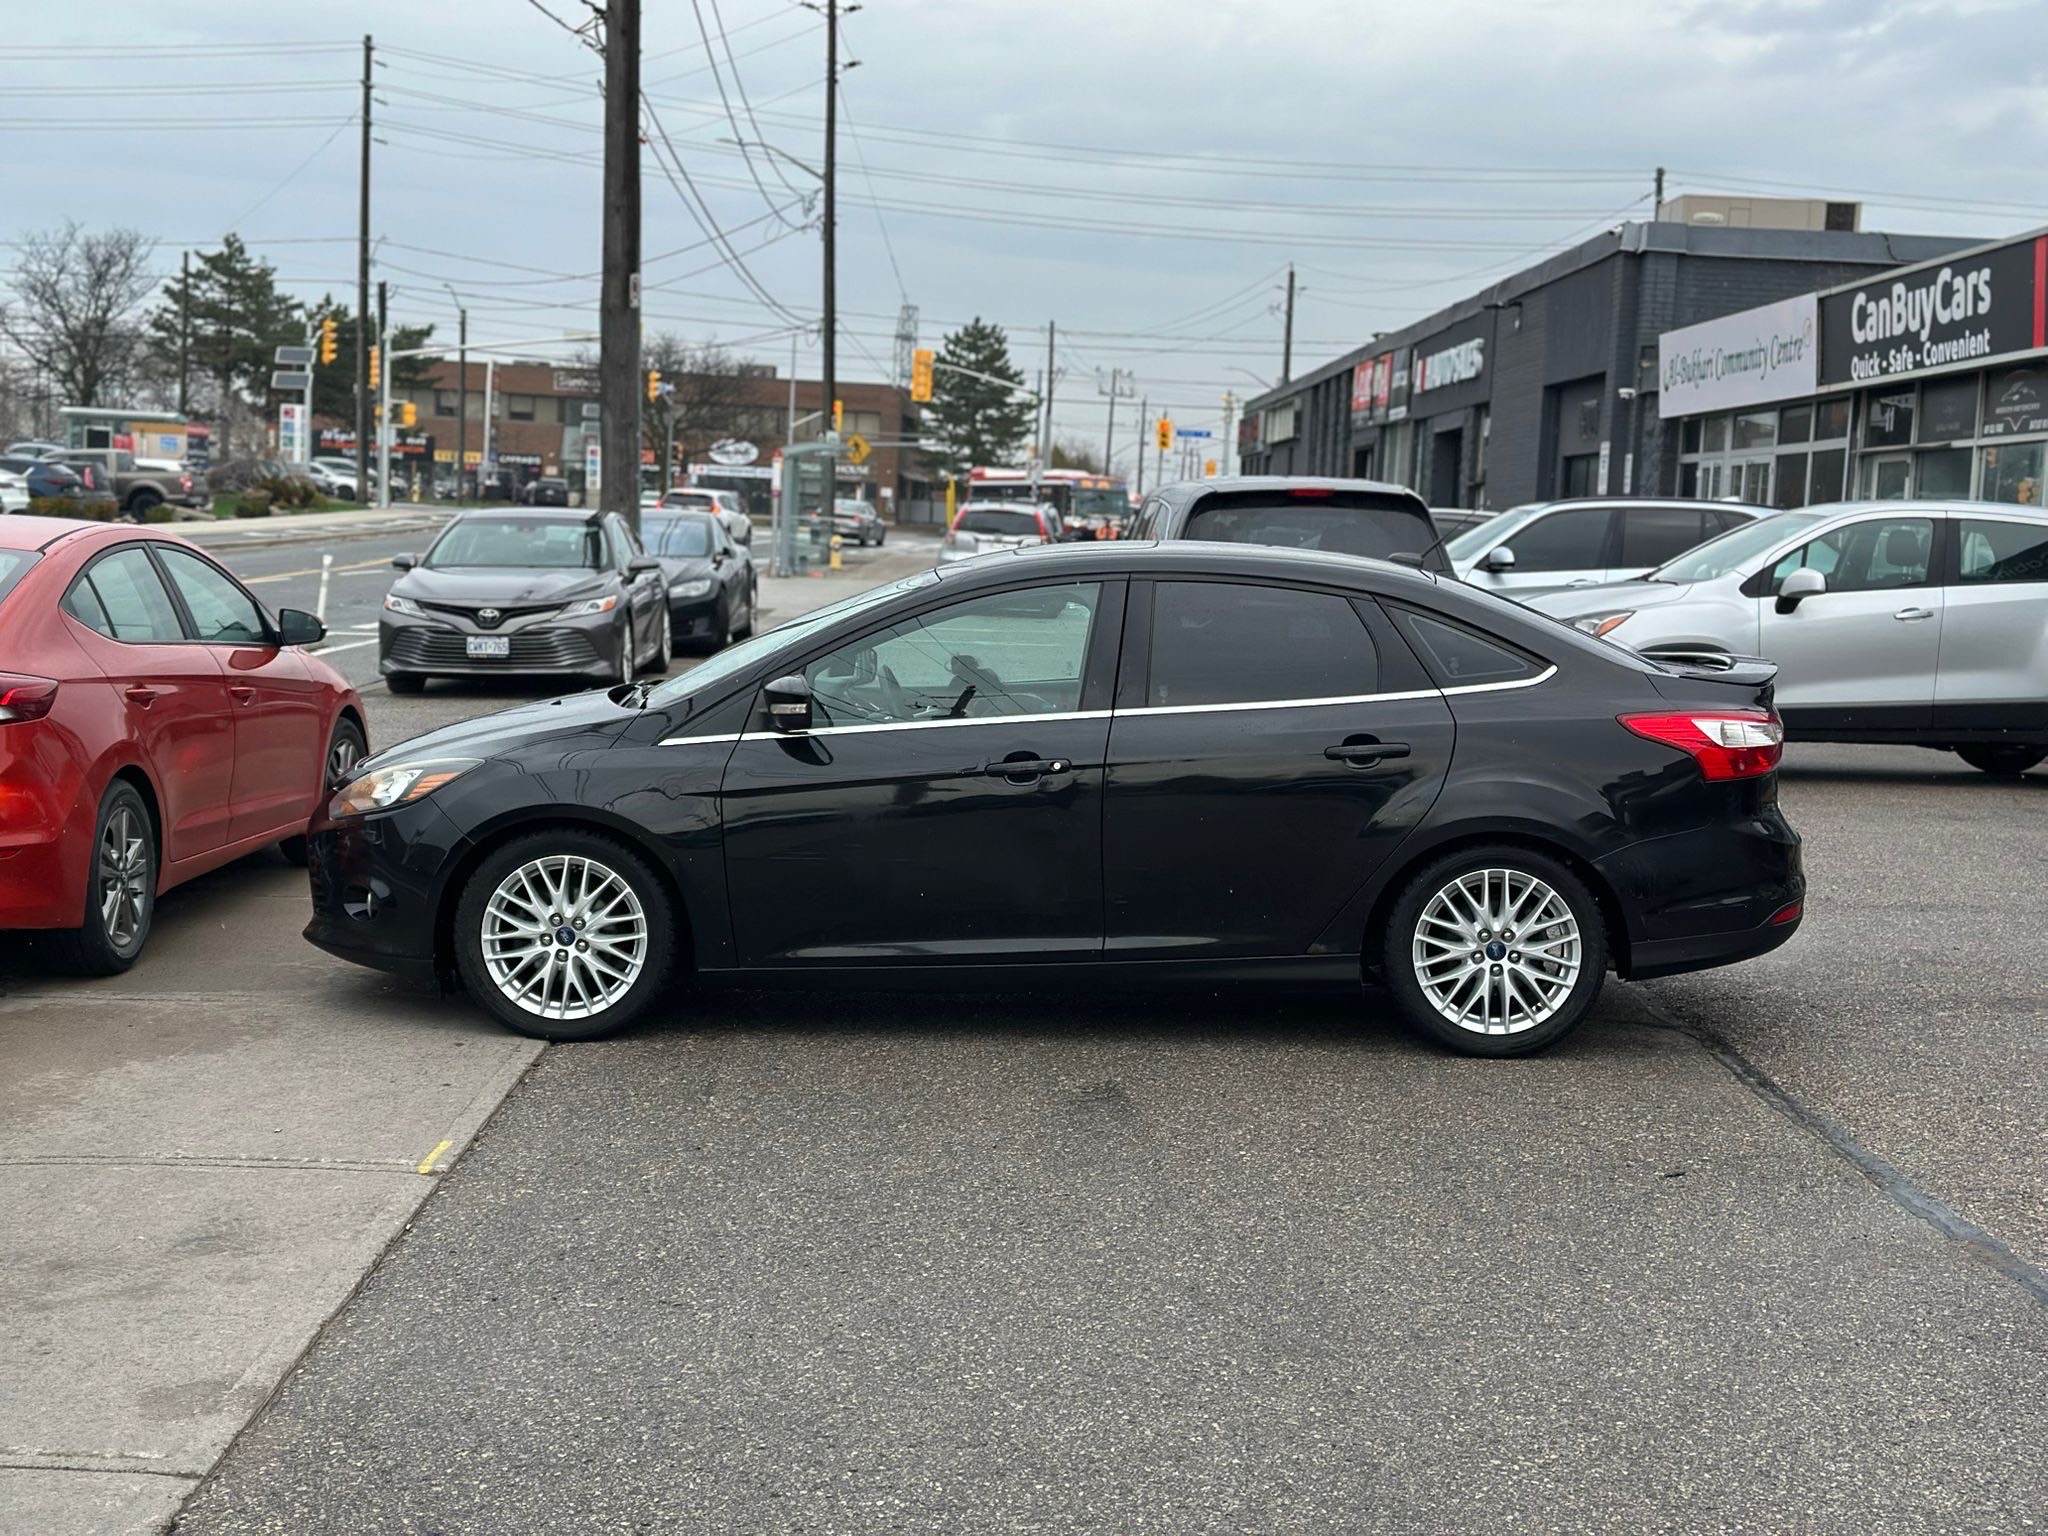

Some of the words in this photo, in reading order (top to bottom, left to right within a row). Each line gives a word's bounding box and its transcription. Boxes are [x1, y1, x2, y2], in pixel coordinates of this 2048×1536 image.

[1852, 267, 1992, 344] CanBuyCars
[1715, 337, 1768, 381] Community
[1770, 333, 1803, 370] Centre
[1851, 351, 1880, 382] Quick
[1888, 344, 1914, 373] Safe
[1923, 328, 1991, 366] Convenient
